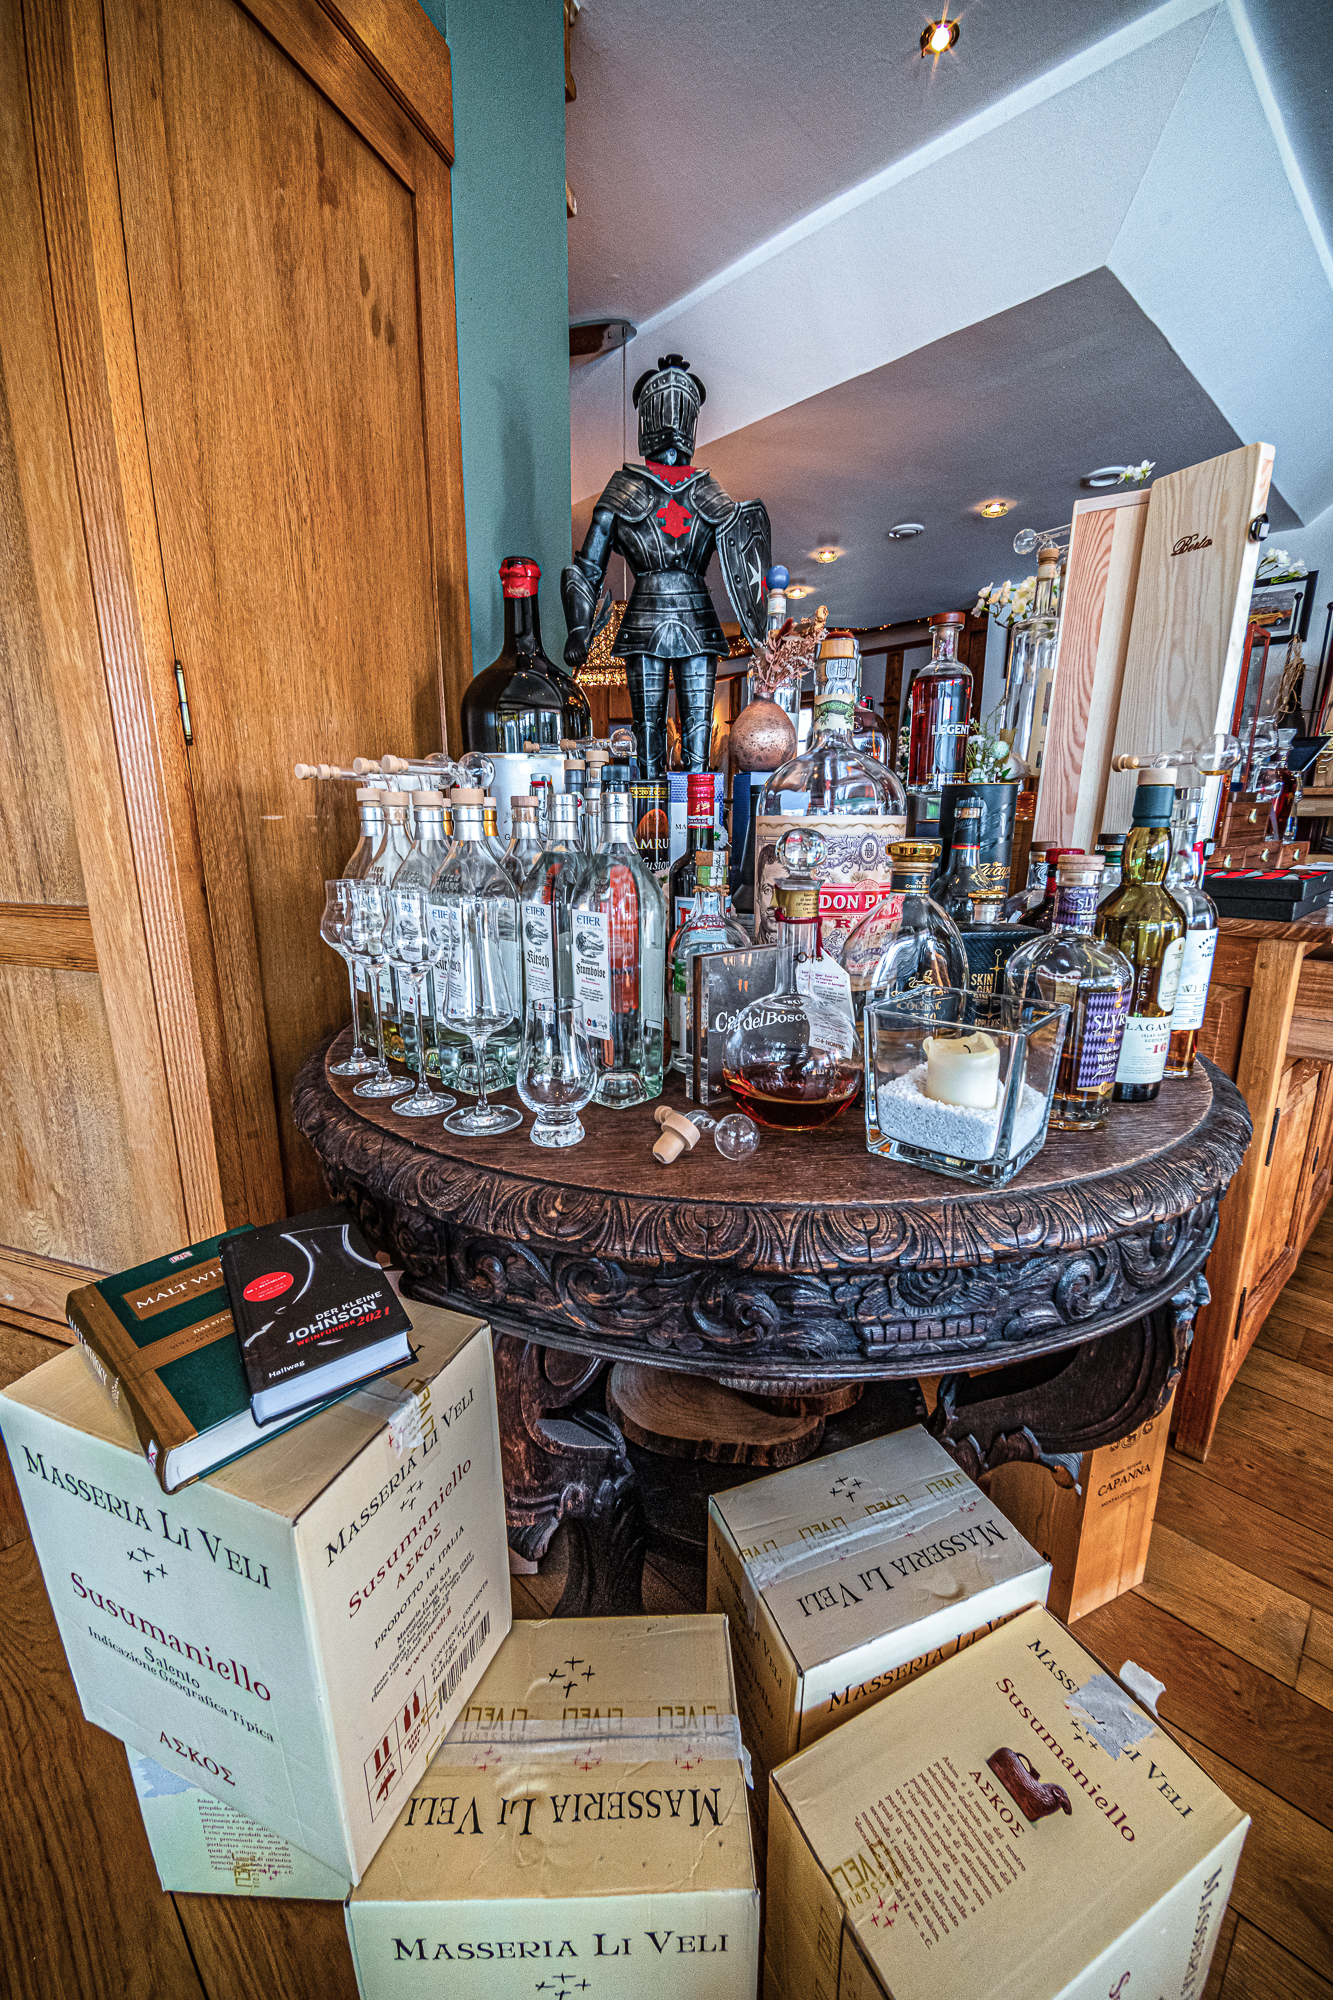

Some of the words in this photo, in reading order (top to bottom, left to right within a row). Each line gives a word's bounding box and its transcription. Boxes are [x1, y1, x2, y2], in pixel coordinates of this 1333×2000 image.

[1170, 534, 1213, 556] Berta
[932, 724, 970, 735] LEGENT
[634, 837, 670, 850] AMRU
[526, 906, 546, 916] ETTER
[576, 914, 600, 926] ETTER
[819, 895, 860, 909] DON
[865, 894, 888, 908] PA
[1077, 896, 1095, 910] SLY
[576, 963, 606, 978] Framboise
[971, 974, 994, 986] SKIN
[1126, 1022, 1172, 1032] LAGAV
[1152, 1043, 1166, 1054] 16
[134, 1281, 188, 1309] MALT
[189, 1266, 222, 1286] WH
[315, 1310, 338, 1321] DER
[341, 1291, 382, 1312] KLEINE
[209, 1312, 230, 1325] STAN
[286, 1300, 377, 1344] JOHNSON
[356, 1306, 390, 1327] 2021
[268, 1360, 306, 1379] Hallwag
[324, 1456, 417, 1568] MASSERIA
[422, 1428, 438, 1458] LI
[440, 1388, 474, 1428] VELI
[1098, 1464, 1150, 1497] CAPANNA
[21, 1445, 152, 1532] MASSERIA
[158, 1510, 192, 1551] LI
[197, 1528, 272, 1590] VELI
[348, 1459, 472, 1618] Susumaniello
[890, 1520, 1008, 1578] MASSERIA
[374, 1580, 424, 1650] PRODOTTO
[426, 1563, 436, 1580] IN
[438, 1526, 464, 1564] ITALIA
[857, 1566, 895, 1592] LI
[796, 1582, 863, 1618] VELI
[70, 1572, 271, 1701] Susumaniello
[404, 1603, 452, 1679] www.liveli.it
[88, 1626, 158, 1678] Indicazione
[158, 1667, 228, 1717] Geografica
[230, 1709, 275, 1743] Tipica
[144, 1646, 200, 1689] Salento
[826, 1644, 946, 1714] MASSERIA
[462, 1706, 504, 1732] VELI
[561, 1708, 602, 1730] VELI
[656, 1706, 698, 1730] VELI
[1026, 1638, 1080, 1695] MASS
[1147, 1760, 1194, 1818] VELI
[942, 1755, 961, 1779] Askos
[996, 1678, 1136, 1843] Susumaniello
[550, 1788, 723, 1827] MASSERIA
[909, 1776, 934, 1809] pugliesi
[933, 1760, 959, 1794] progetto
[957, 1793, 983, 1828] dedicato
[404, 1796, 484, 1835] VELI
[497, 1797, 536, 1836] LI
[917, 1771, 949, 1813] patrimonio
[954, 1824, 977, 1855] vitigni
[926, 1765, 953, 1801] selezione
[955, 1807, 1000, 1871] valorizzazione
[868, 1804, 893, 1838] secondo
[893, 1843, 915, 1875] canoni
[905, 1807, 942, 1859] provenienti
[906, 1787, 921, 1806] vini
[919, 1807, 935, 1828] sono
[931, 1828, 960, 1867] prodotti
[957, 1865, 974, 1887] solo
[971, 1887, 985, 1906] con
[875, 1798, 895, 1823] quali
[899, 1837, 927, 1874] vitigno
[933, 1887, 961, 1928] allevato
[884, 1793, 919, 1842] particolare
[917, 1842, 951, 1892] vocazione
[950, 1893, 969, 1920] nelle
[391, 1937, 578, 1961] MASSERIA
[593, 1933, 632, 1957] LI
[644, 1930, 729, 1954] VELI
